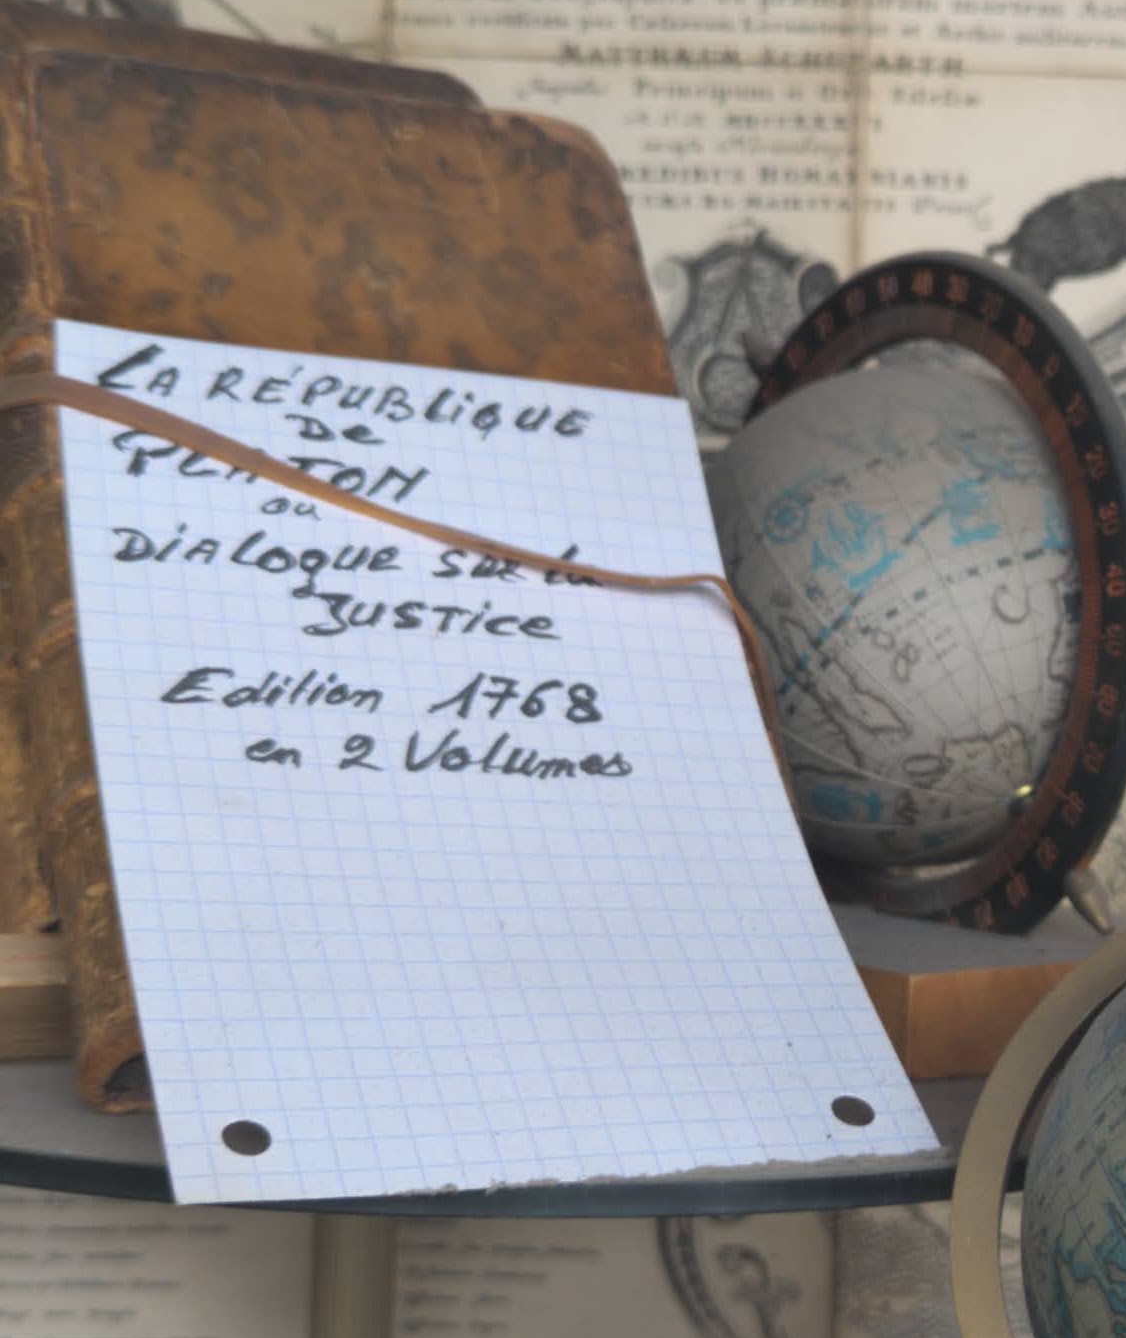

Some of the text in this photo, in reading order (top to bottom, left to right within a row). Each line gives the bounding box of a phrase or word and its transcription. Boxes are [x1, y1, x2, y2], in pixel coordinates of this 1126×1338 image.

[98, 344, 181, 397] LA
[160, 666, 604, 725] Edition 1768
[244, 729, 634, 781] en 2 Volumes
